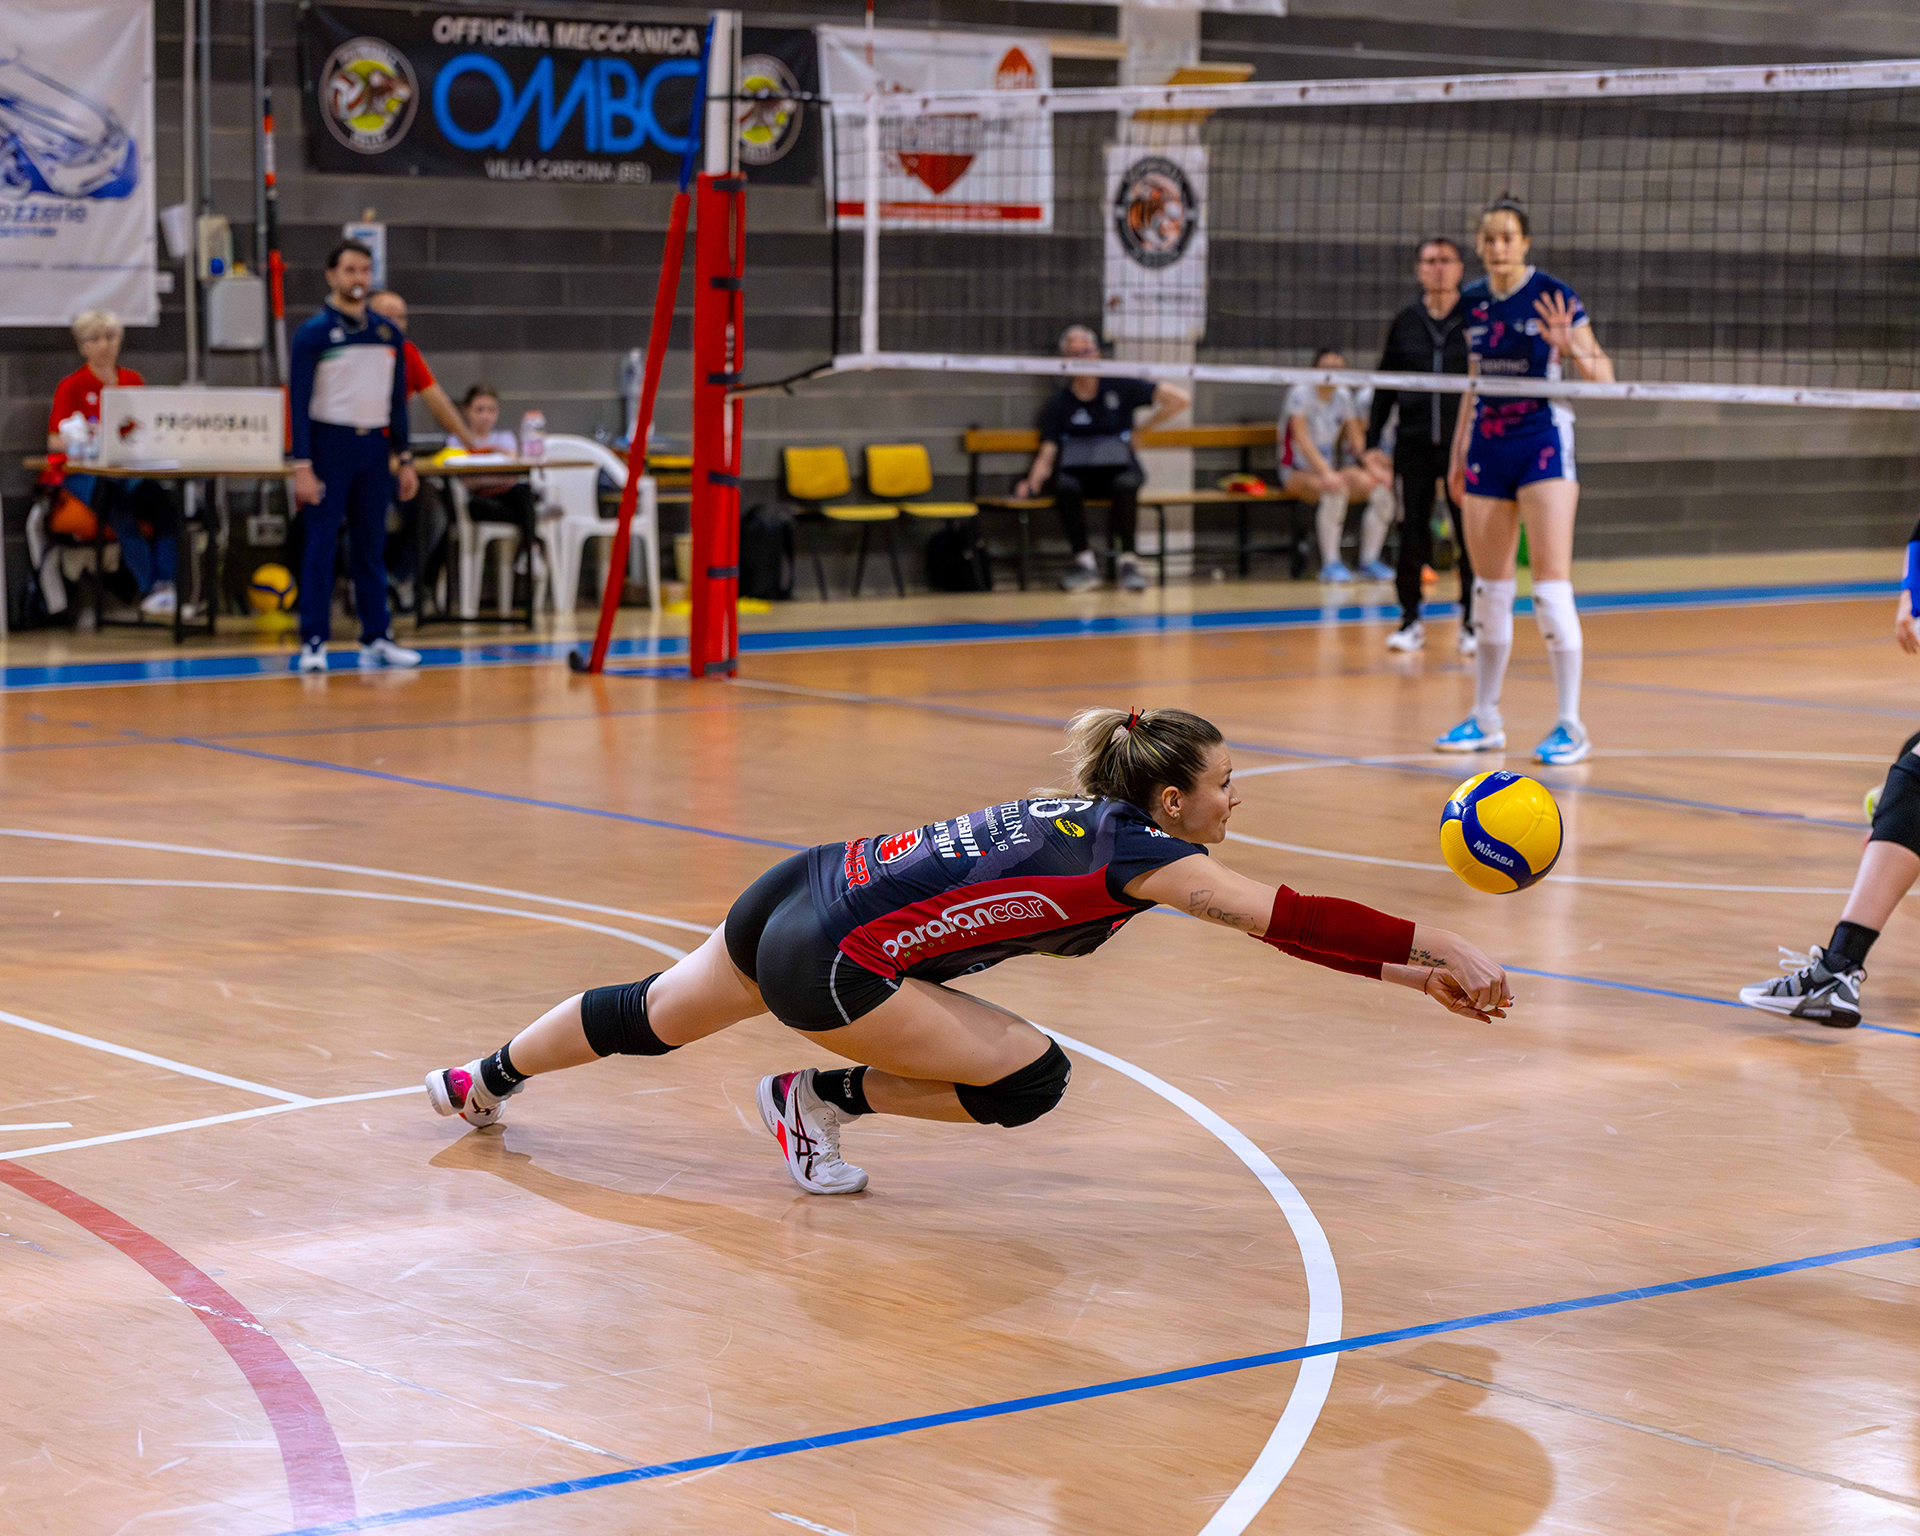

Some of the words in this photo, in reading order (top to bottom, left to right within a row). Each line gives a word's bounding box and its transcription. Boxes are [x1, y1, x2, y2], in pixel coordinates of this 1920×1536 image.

[432, 15, 550, 48] OFFICINA
[553, 22, 701, 54] MECCANICA
[432, 52, 700, 153] OMBC
[484, 157, 533, 180] VILLA
[881, 891, 1066, 958] parafancar
[903, 938, 947, 959] MADE
[960, 929, 977, 938] IN
